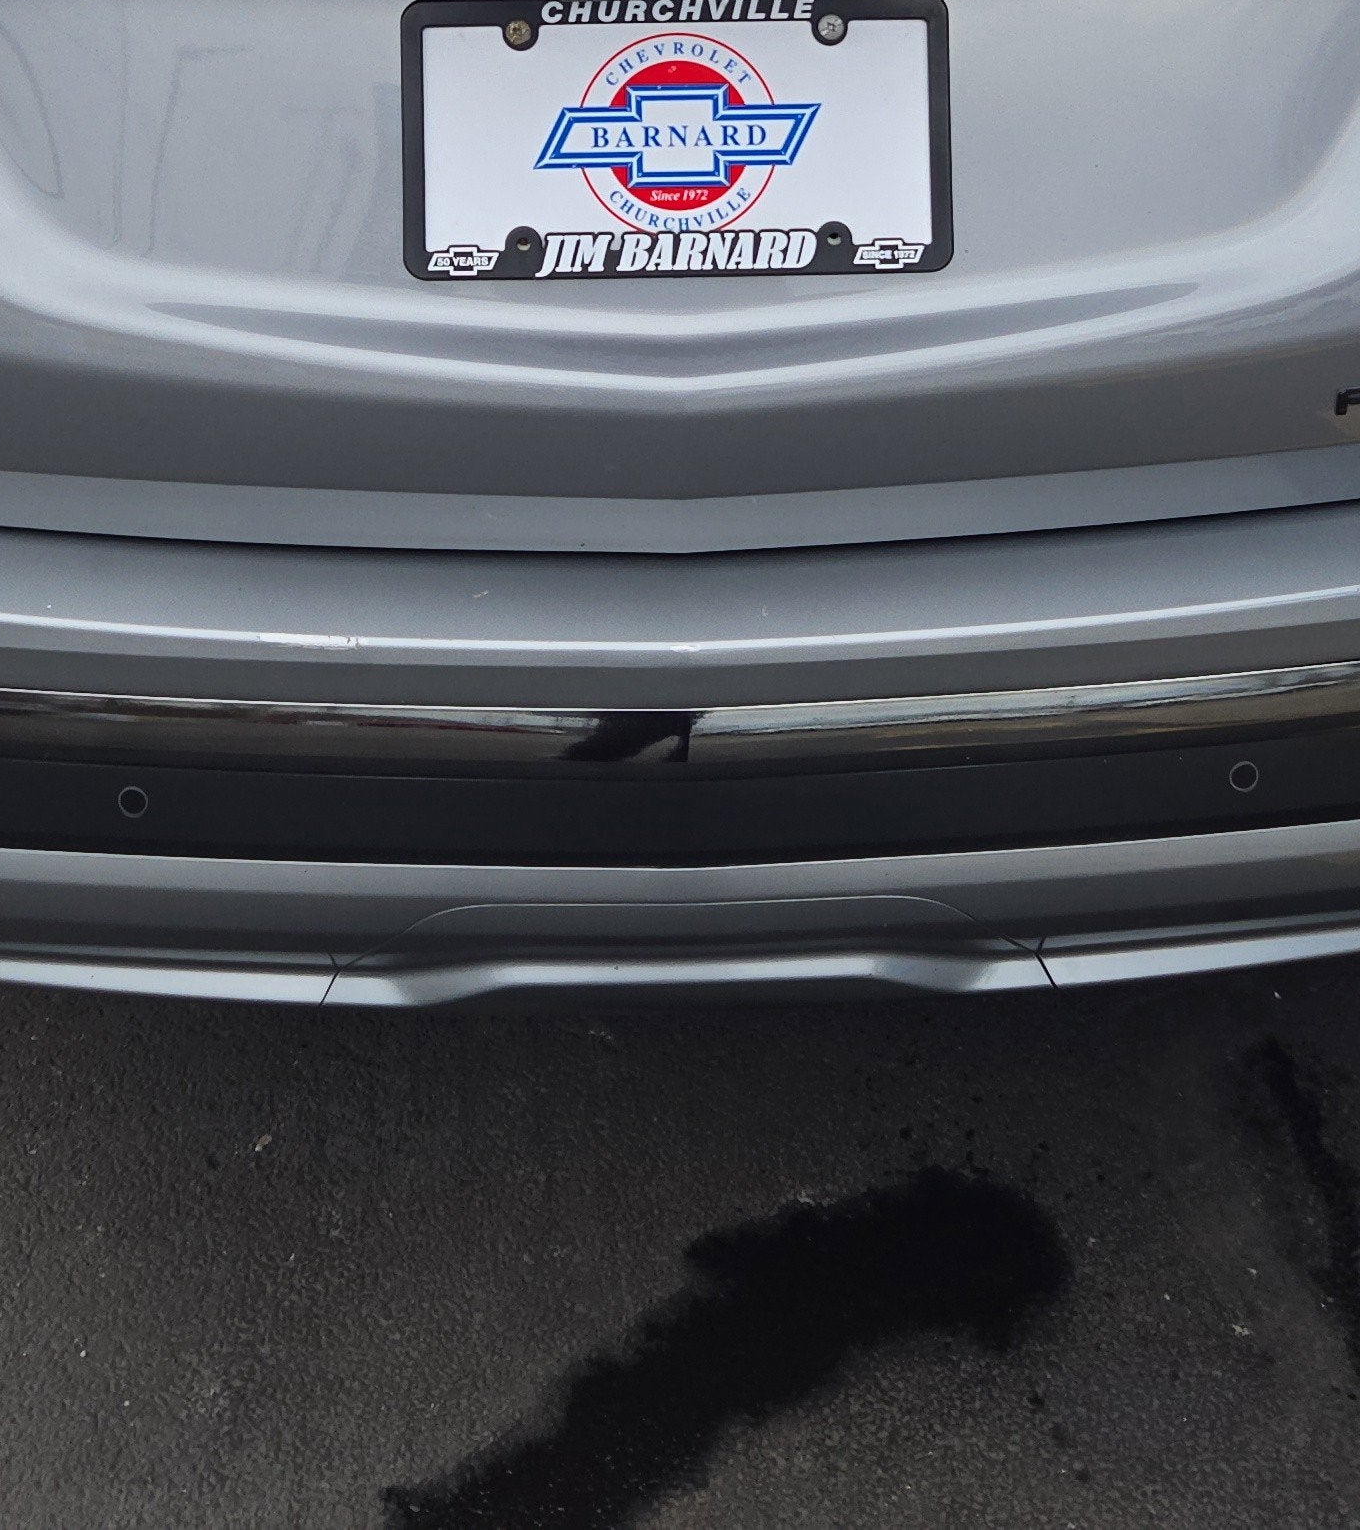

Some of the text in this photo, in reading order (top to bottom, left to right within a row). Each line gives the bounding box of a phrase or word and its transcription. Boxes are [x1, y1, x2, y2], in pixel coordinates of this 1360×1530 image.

[605, 41, 754, 88] CHEVROLET
[592, 124, 767, 149] BARNARD
[609, 187, 752, 231] CHURCHVILLE
[650, 189, 709, 201] Since 1972
[437, 256, 489, 267] 50 YEARS
[535, 230, 817, 278] JIM BARNARD
